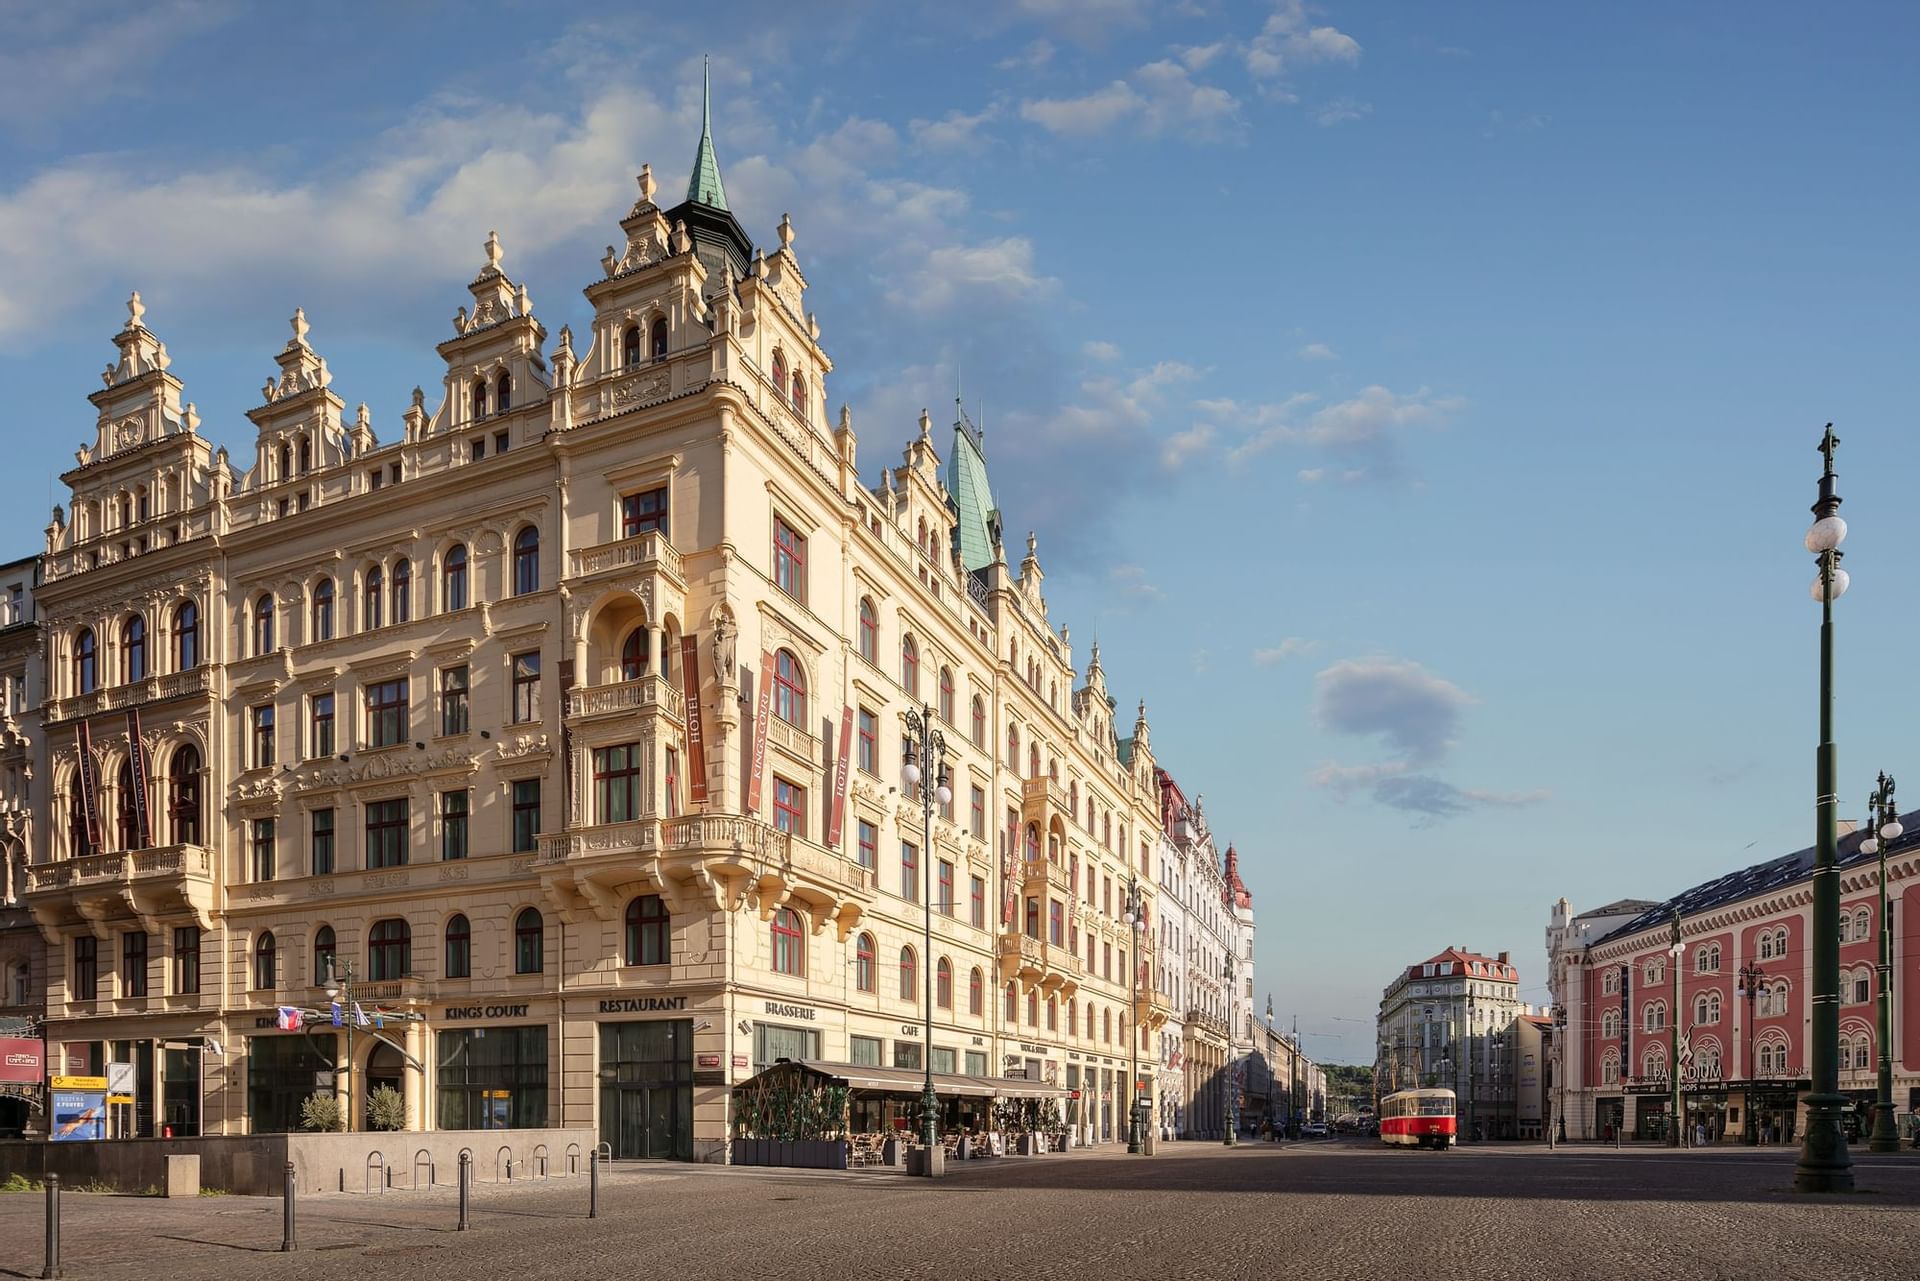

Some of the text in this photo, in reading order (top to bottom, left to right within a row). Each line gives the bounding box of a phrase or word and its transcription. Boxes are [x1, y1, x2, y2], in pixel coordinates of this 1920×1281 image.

[688, 692, 700, 743] HOTEL
[753, 693, 769, 779] KINGS COURT
[836, 757, 847, 798] HOTEL
[445, 1004, 529, 1020] KINGS COURT
[600, 997, 688, 1013] RESTAURANT
[765, 1001, 816, 1021] BRASSERIE
[901, 1025, 919, 1037] CAFE
[972, 1036, 983, 1046] BAR
[1654, 1065, 1722, 1081] PALADIUM
[1757, 1066, 1809, 1076] SHOPPING
[1679, 1084, 1698, 1092] HOPS
